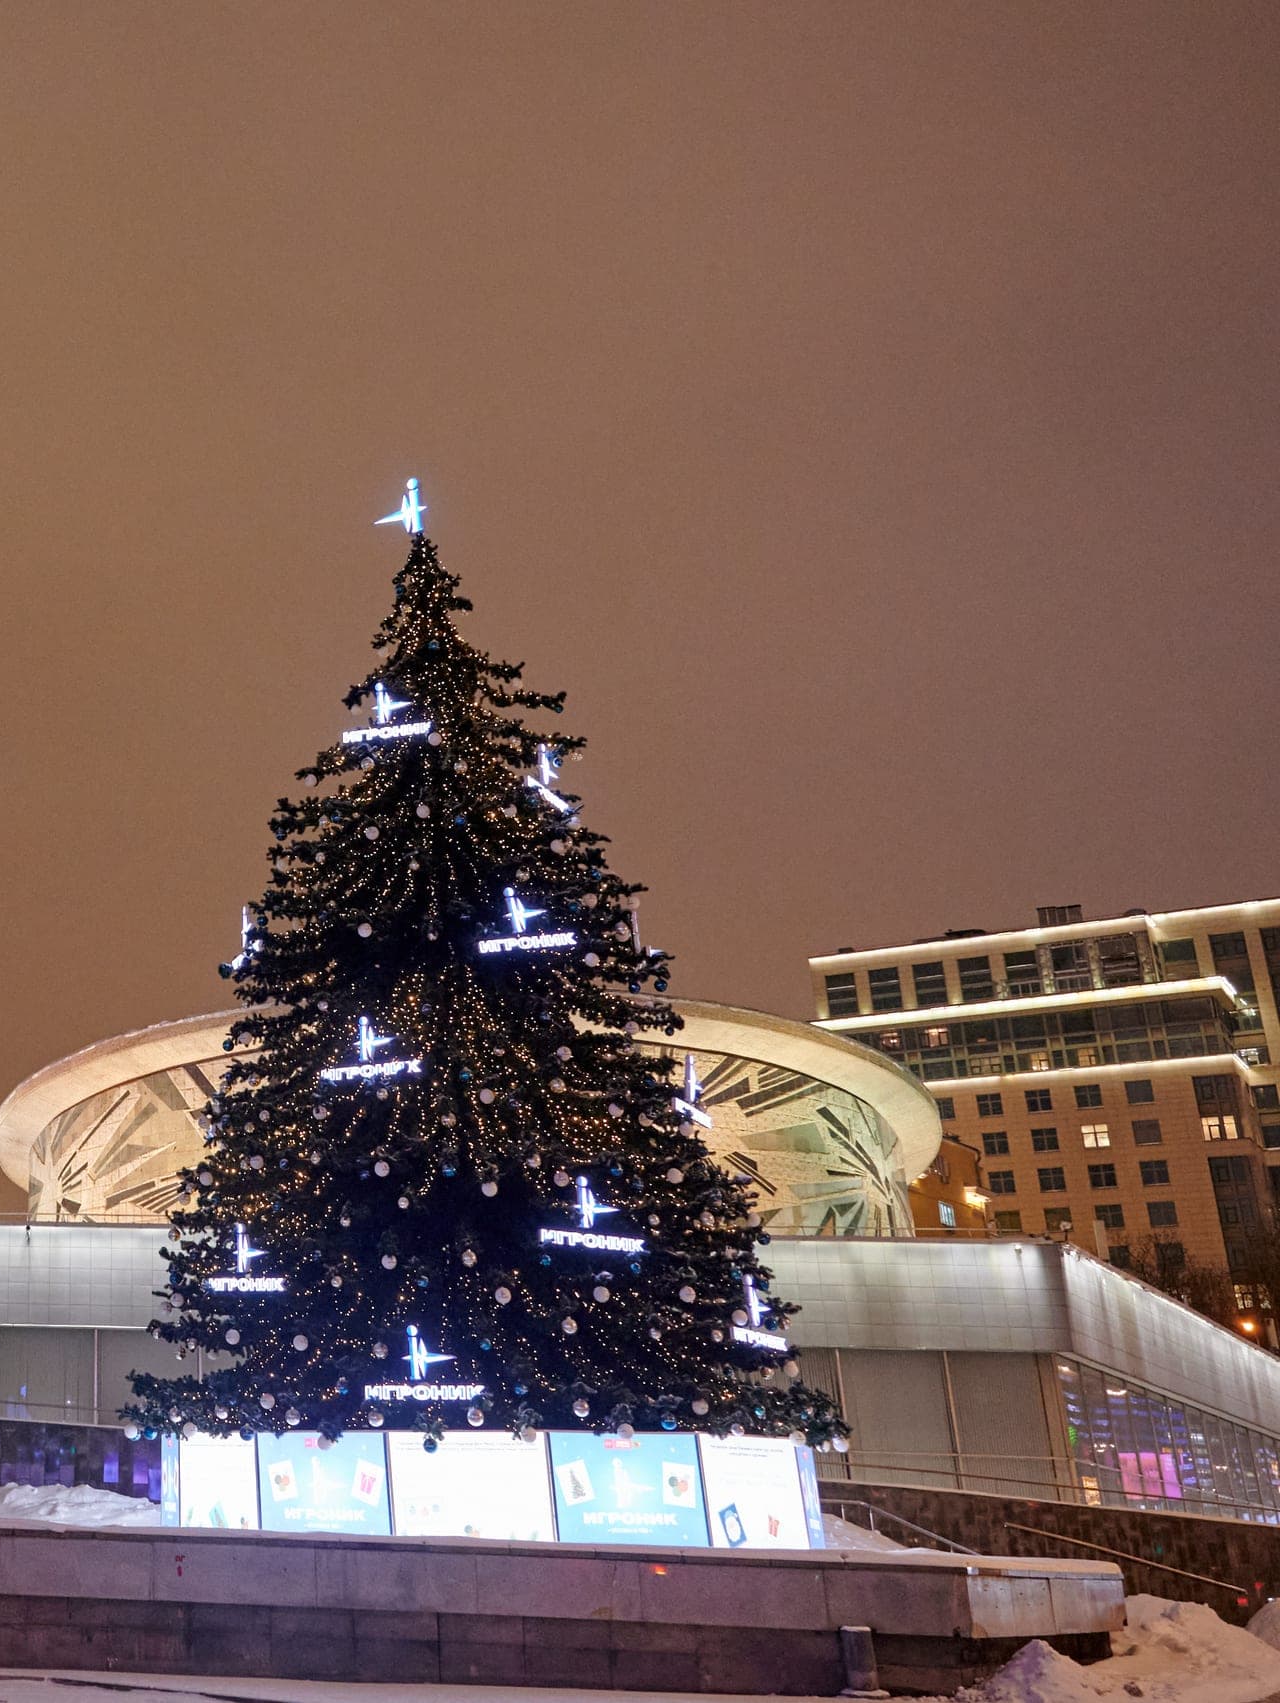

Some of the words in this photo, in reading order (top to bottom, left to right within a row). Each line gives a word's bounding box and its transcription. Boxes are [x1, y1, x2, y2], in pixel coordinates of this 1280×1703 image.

[342, 722, 431, 744] ИГРОНИК
[478, 932, 577, 953] ИГРОНИК
[320, 1059, 422, 1081] ИГРОНИК
[540, 1228, 645, 1252] ИГРОНИК
[208, 1277, 284, 1292] ИГРОНИК
[365, 1385, 484, 1400] ИГРОНИК
[283, 1508, 367, 1521] ИГРОНИК
[582, 1511, 678, 1525] ИГРОНИК
